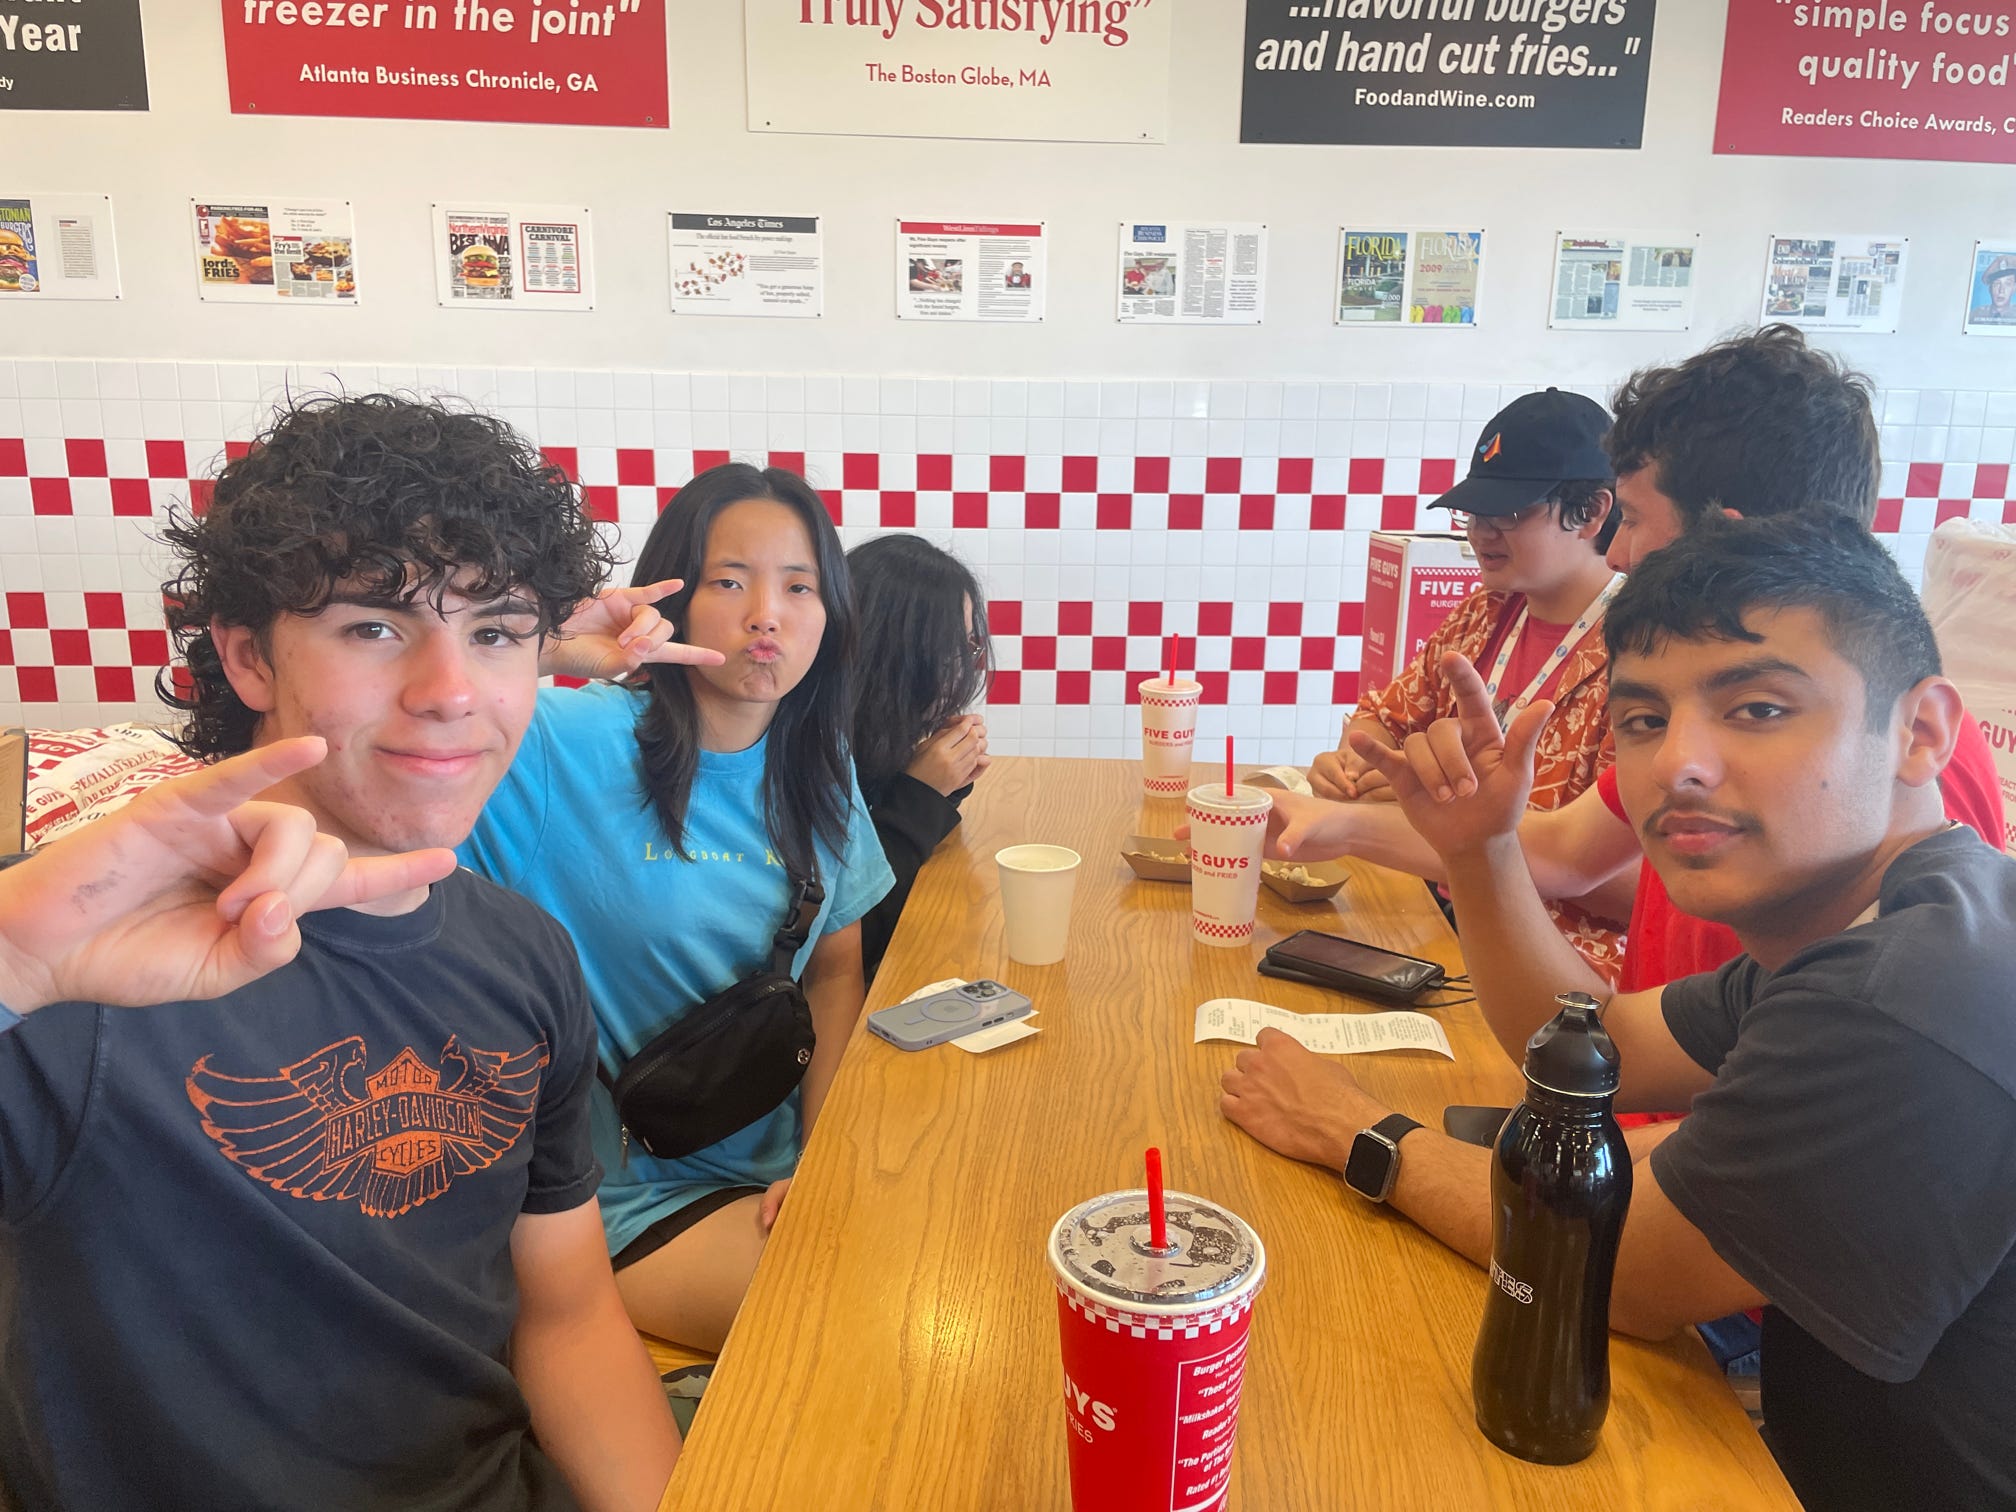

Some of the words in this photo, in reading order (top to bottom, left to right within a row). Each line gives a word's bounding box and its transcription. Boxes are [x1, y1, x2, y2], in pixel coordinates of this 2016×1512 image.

[243, 0, 389, 28] freezer
[404, 0, 437, 30] in
[453, 0, 515, 33] the
[1919, 1, 2011, 37] focus
[0, 14, 82, 52] Year
[1254, 30, 1330, 72] and
[1335, 31, 1433, 74] hand
[1438, 35, 1501, 75] cut
[299, 63, 370, 85] Atlanta
[375, 66, 460, 87] Business
[465, 69, 561, 94] Chronicle,
[566, 73, 599, 93] GA
[865, 63, 897, 82] The
[901, 65, 957, 85] Boston
[960, 67, 1014, 88] Globe,
[1019, 69, 1051, 88] MA
[1797, 47, 1921, 90] quality
[1354, 88, 1536, 108] FoodandWine.com
[1781, 107, 1854, 127] Readers
[1859, 110, 1920, 130] Choice
[1924, 113, 1997, 136] Awards,
[0, 207, 31, 222] TONIAN
[707, 217, 723, 227] Los
[724, 217, 756, 229] Angeles
[758, 218, 784, 229] Times
[525, 225, 574, 234] CARNIVORE
[529, 233, 571, 242] CARNIVAL
[1346, 236, 1403, 261] FLORIDA
[203, 258, 228, 268] lord
[204, 267, 240, 278] FRIES
[1419, 264, 1443, 273] 2009
[1419, 580, 1465, 596] FIVE
[1144, 727, 1169, 739] FIVE
[29, 741, 78, 754] ECT
[70, 758, 123, 793] SPECIALLY
[644, 842, 744, 862] LOGBOAT
[1202, 853, 1249, 869] GUYS
[376, 1058, 432, 1091] MOTOR
[330, 1094, 480, 1159] HARLEY-DAVIDSON
[377, 1139, 437, 1167] CYCLES
[1193, 1360, 1224, 1377] Burger
[1185, 1478, 1211, 1497] Rated
